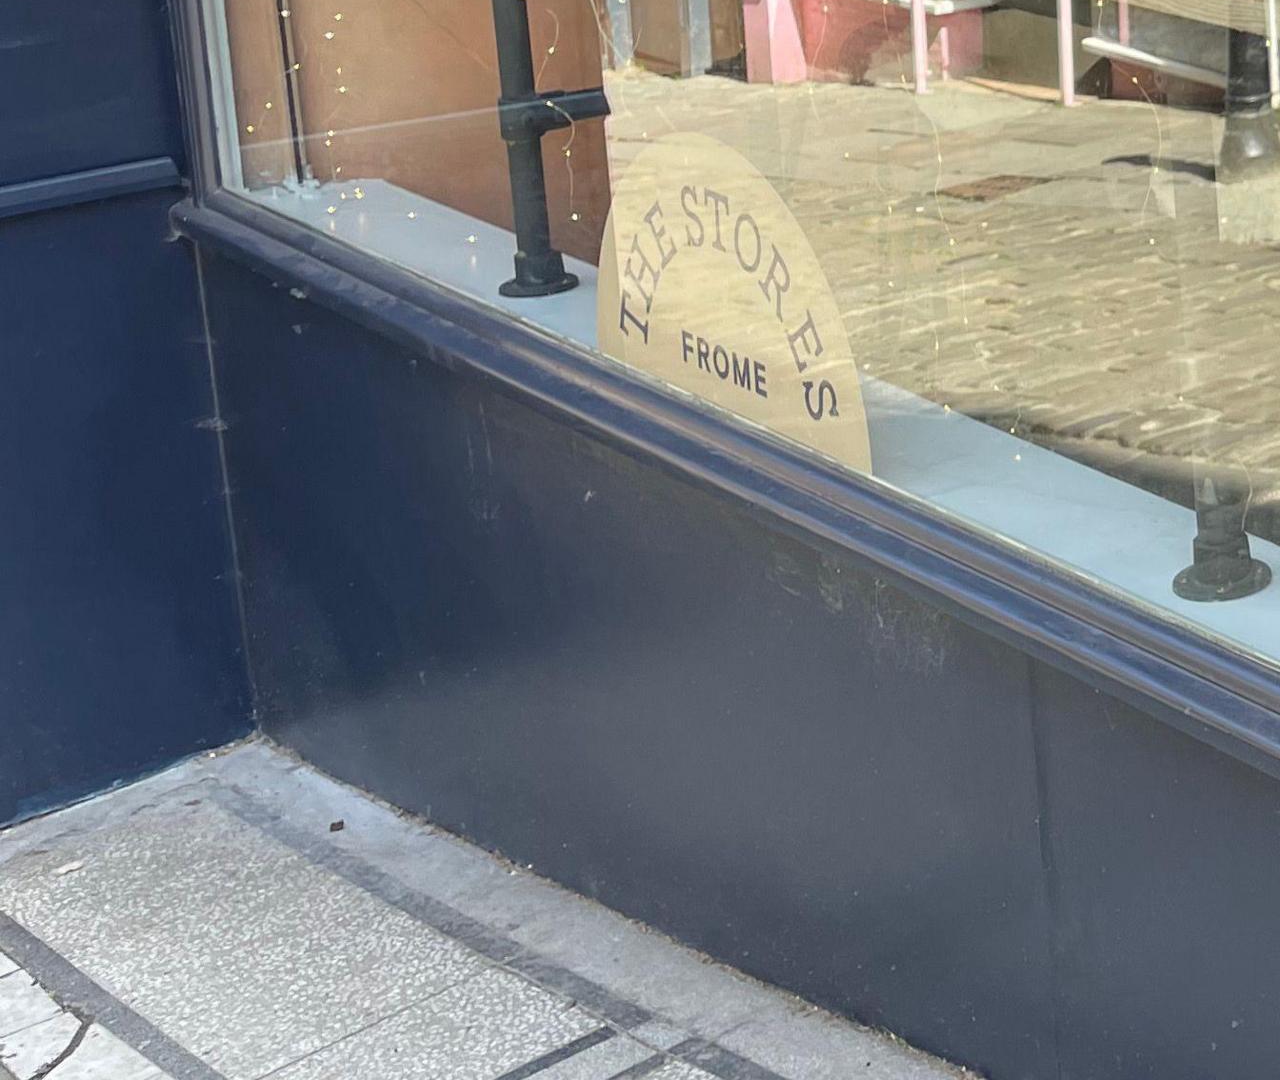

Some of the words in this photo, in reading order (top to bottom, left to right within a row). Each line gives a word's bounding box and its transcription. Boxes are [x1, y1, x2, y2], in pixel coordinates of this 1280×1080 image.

[619, 200, 678, 345] THE
[680, 184, 839, 421] STORES
[681, 330, 768, 398] FROME
